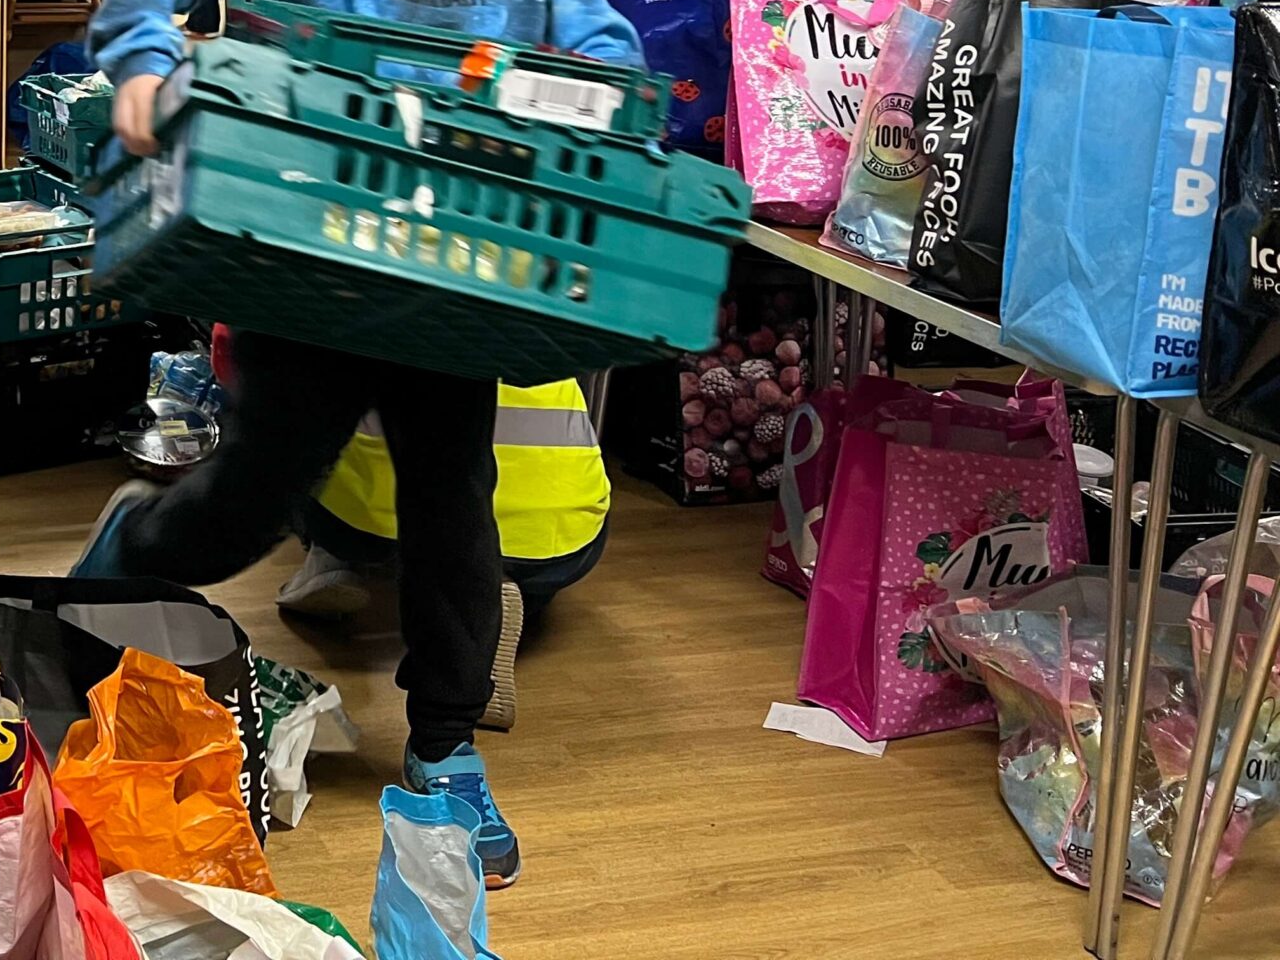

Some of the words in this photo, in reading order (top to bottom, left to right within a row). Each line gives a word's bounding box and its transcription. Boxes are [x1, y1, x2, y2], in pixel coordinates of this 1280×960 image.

[922, 18, 956, 155] AMAZING
[949, 44, 978, 145] GREAT
[875, 125, 917, 150] 100%
[866, 157, 921, 177] REUSABLE
[1161, 273, 1186, 292] I'M
[1158, 294, 1204, 314] MADE
